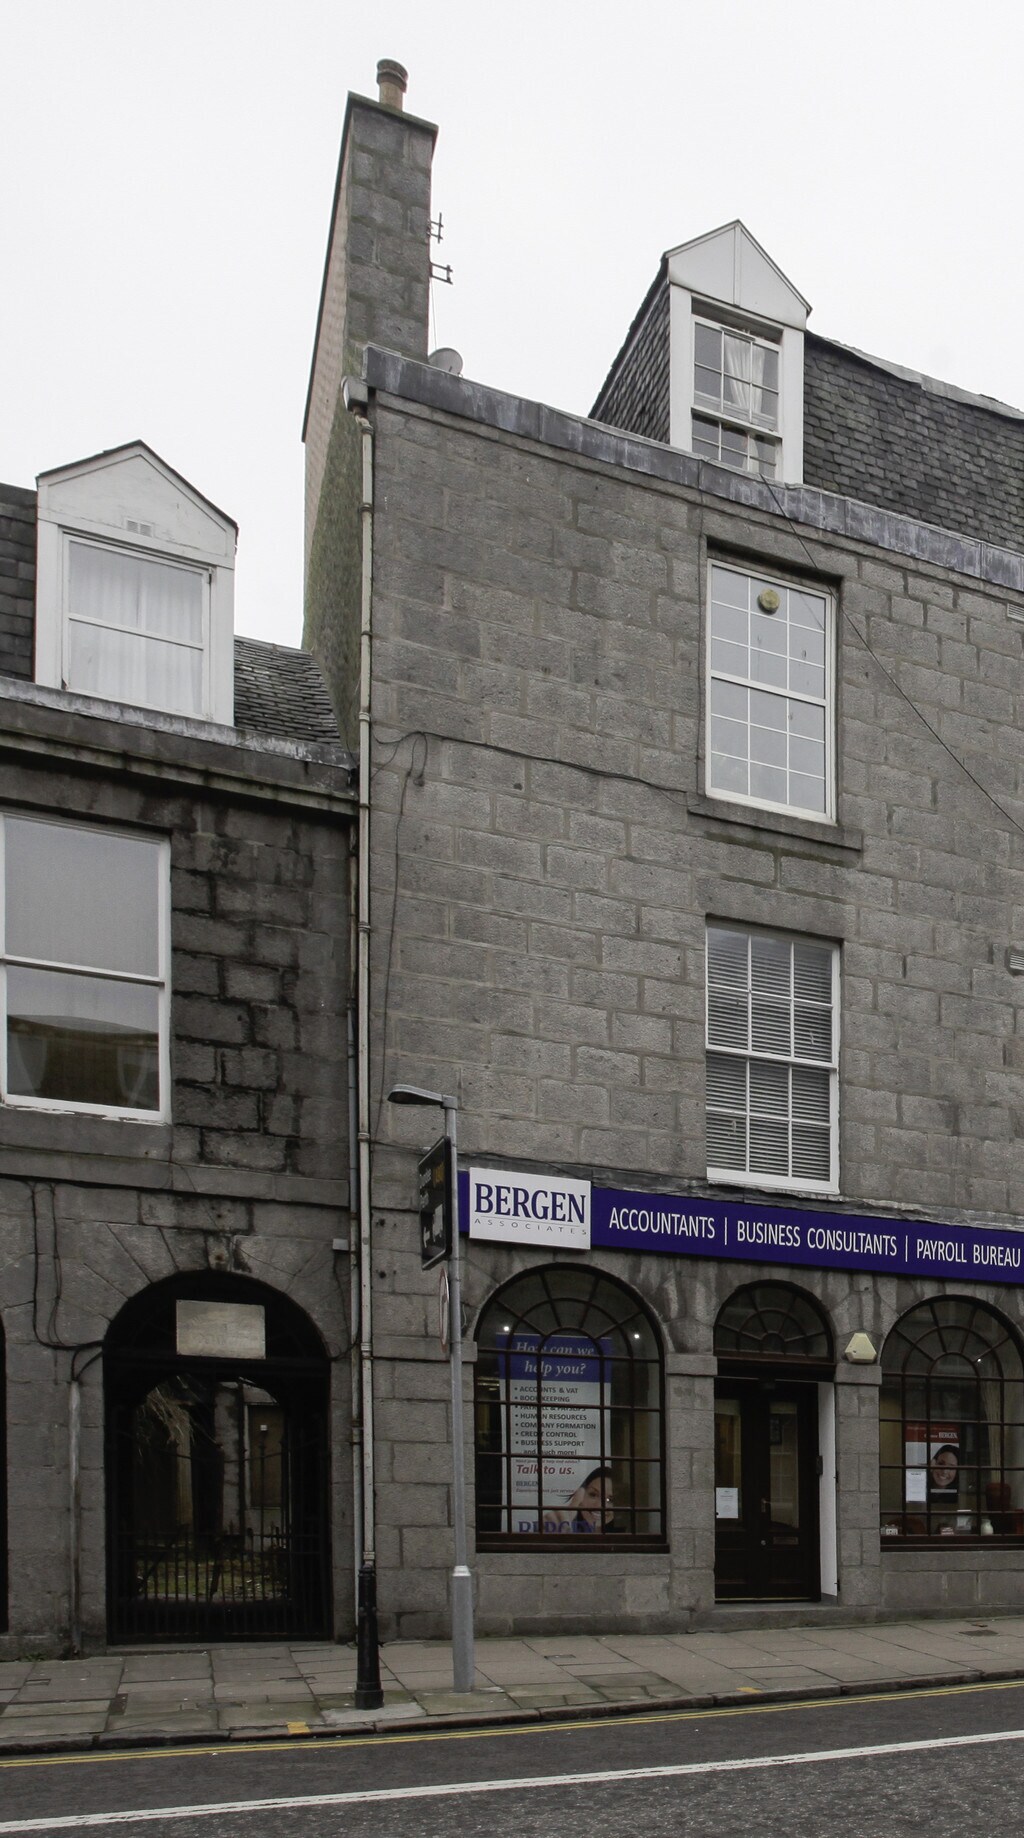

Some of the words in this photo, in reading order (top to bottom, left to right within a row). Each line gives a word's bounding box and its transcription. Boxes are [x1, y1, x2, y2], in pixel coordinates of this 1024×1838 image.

[475, 1183, 586, 1223] BERGEN
[609, 1207, 716, 1239] ACCOUNTANTS
[737, 1220, 801, 1247] BUSINESS
[807, 1228, 898, 1256] CONSULTANTS
[916, 1239, 967, 1263] PAYROLL
[973, 1244, 1021, 1268] BUREAU
[549, 1345, 572, 1354] can
[555, 1363, 586, 1377] you?
[520, 1386, 556, 1394] ACCONTS
[556, 1422, 596, 1430] FORMATION
[544, 1465, 555, 1474] to
[559, 1466, 575, 1474] us.
